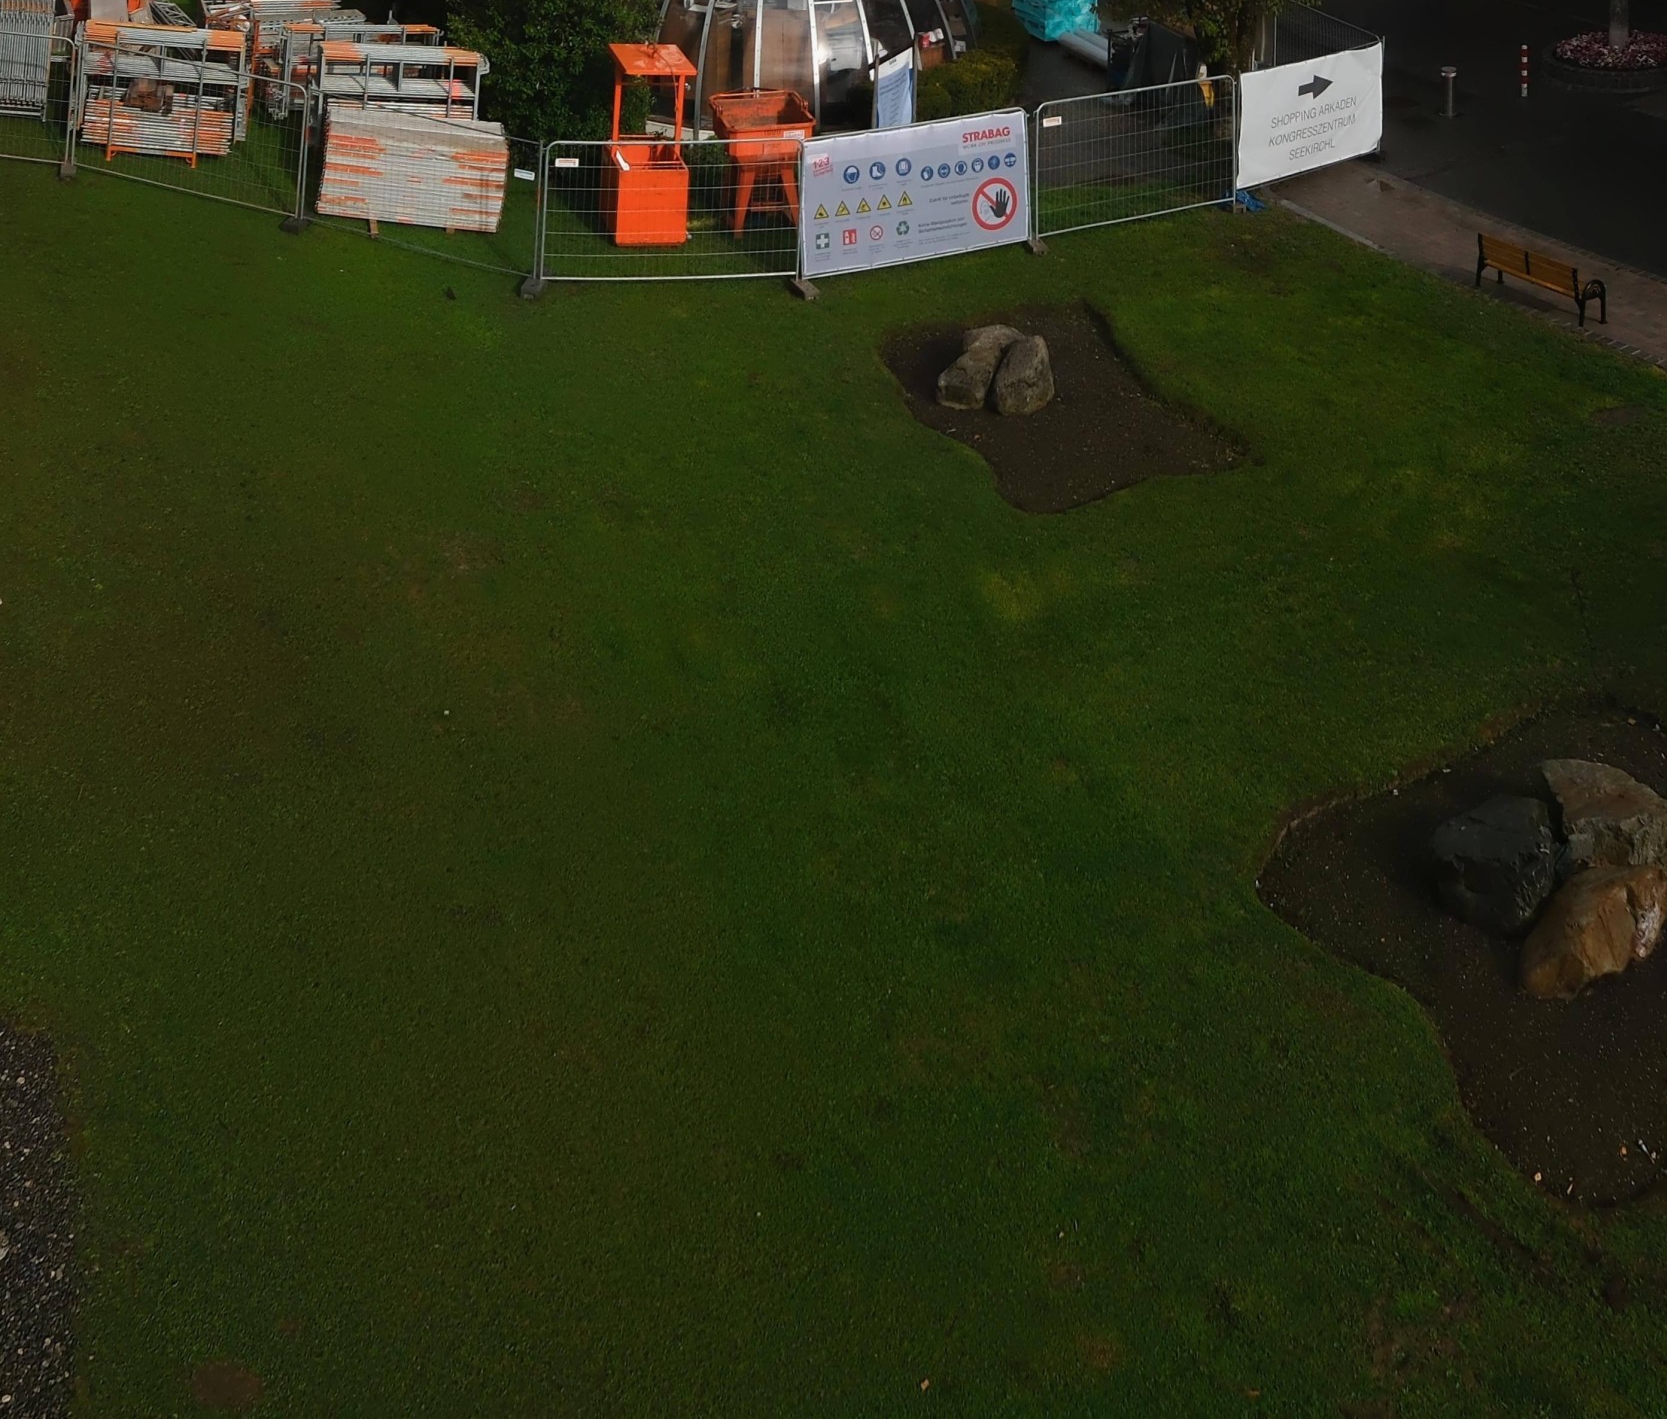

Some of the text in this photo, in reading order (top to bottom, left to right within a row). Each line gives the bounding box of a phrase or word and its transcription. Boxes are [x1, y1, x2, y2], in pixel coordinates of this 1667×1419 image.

[1270, 96, 1357, 129] SHOPPING ARKADEN
[962, 126, 1011, 143] STRABAG
[1268, 113, 1356, 147] KONGRESSZENTRUM
[1288, 138, 1336, 161] SEEKIRCHL
